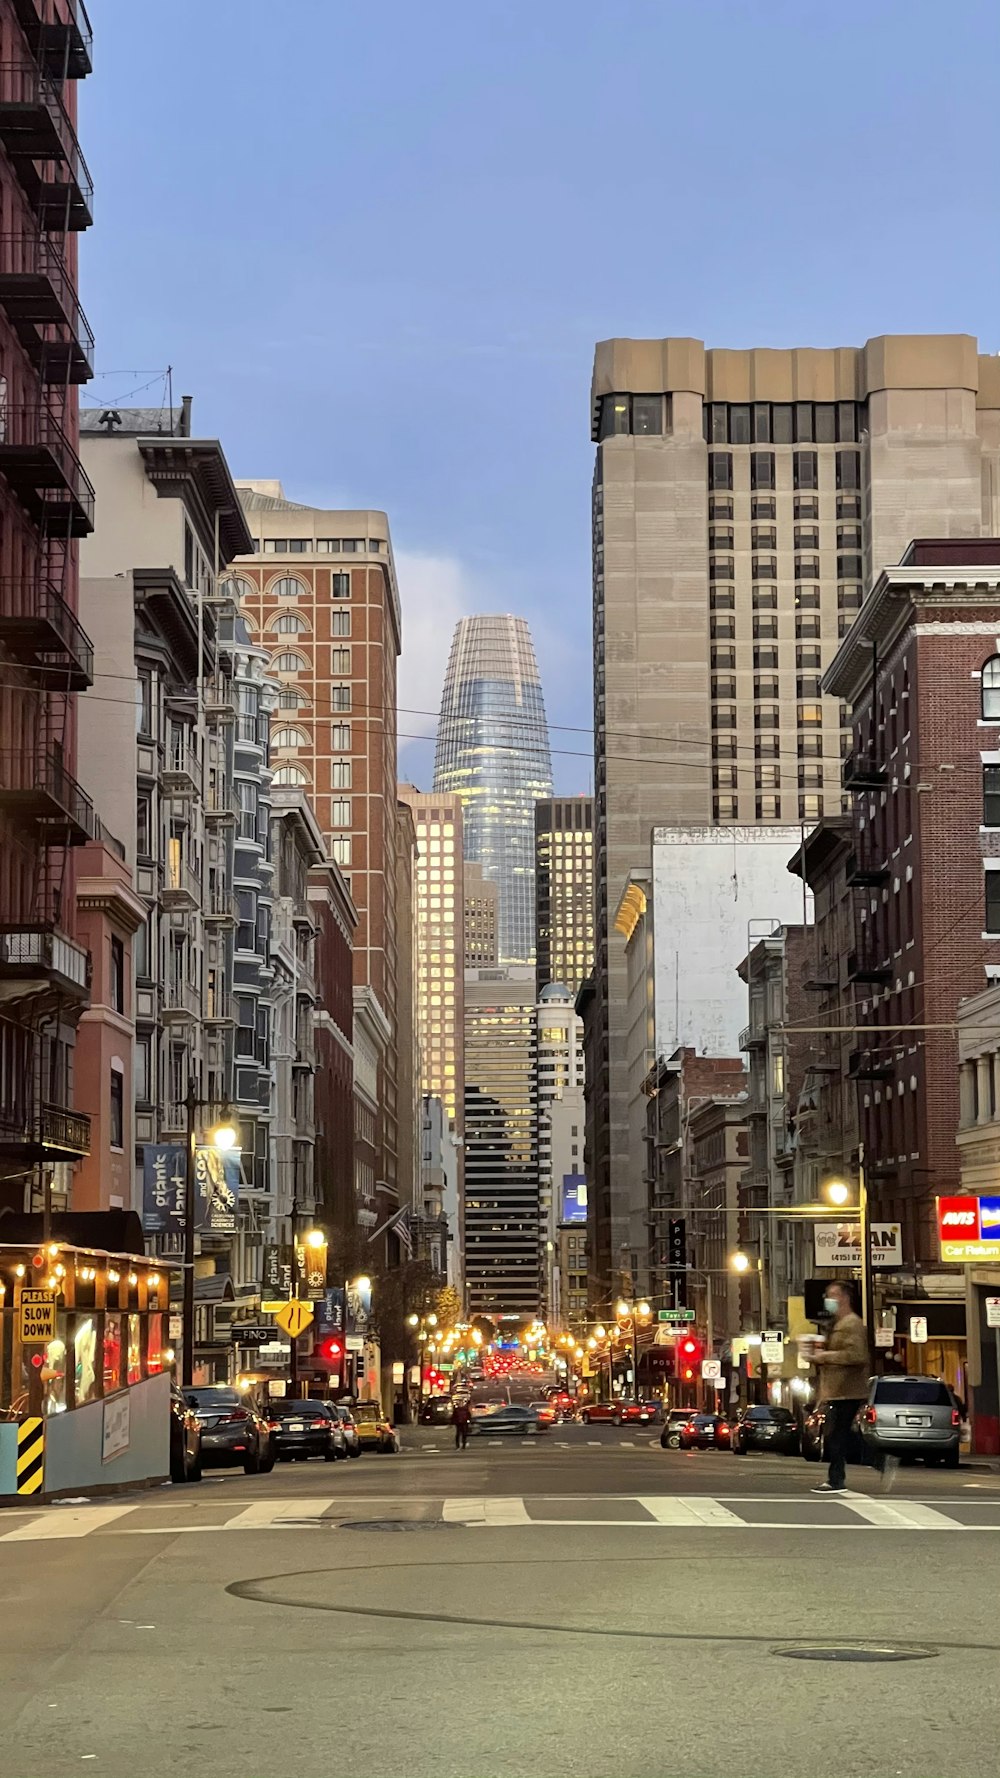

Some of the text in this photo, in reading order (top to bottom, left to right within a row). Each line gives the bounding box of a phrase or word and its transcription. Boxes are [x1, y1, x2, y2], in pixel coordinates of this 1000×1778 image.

[170, 1177, 184, 1216] land
[198, 1182, 207, 1198] and
[942, 1211, 976, 1225] AVIS
[945, 1245, 999, 1256] Car Return
[22, 1291, 54, 1302] PLEASE
[24, 1307, 51, 1320] SLOW
[23, 1323, 52, 1336] DOWN
[243, 1330, 268, 1340] FINO
